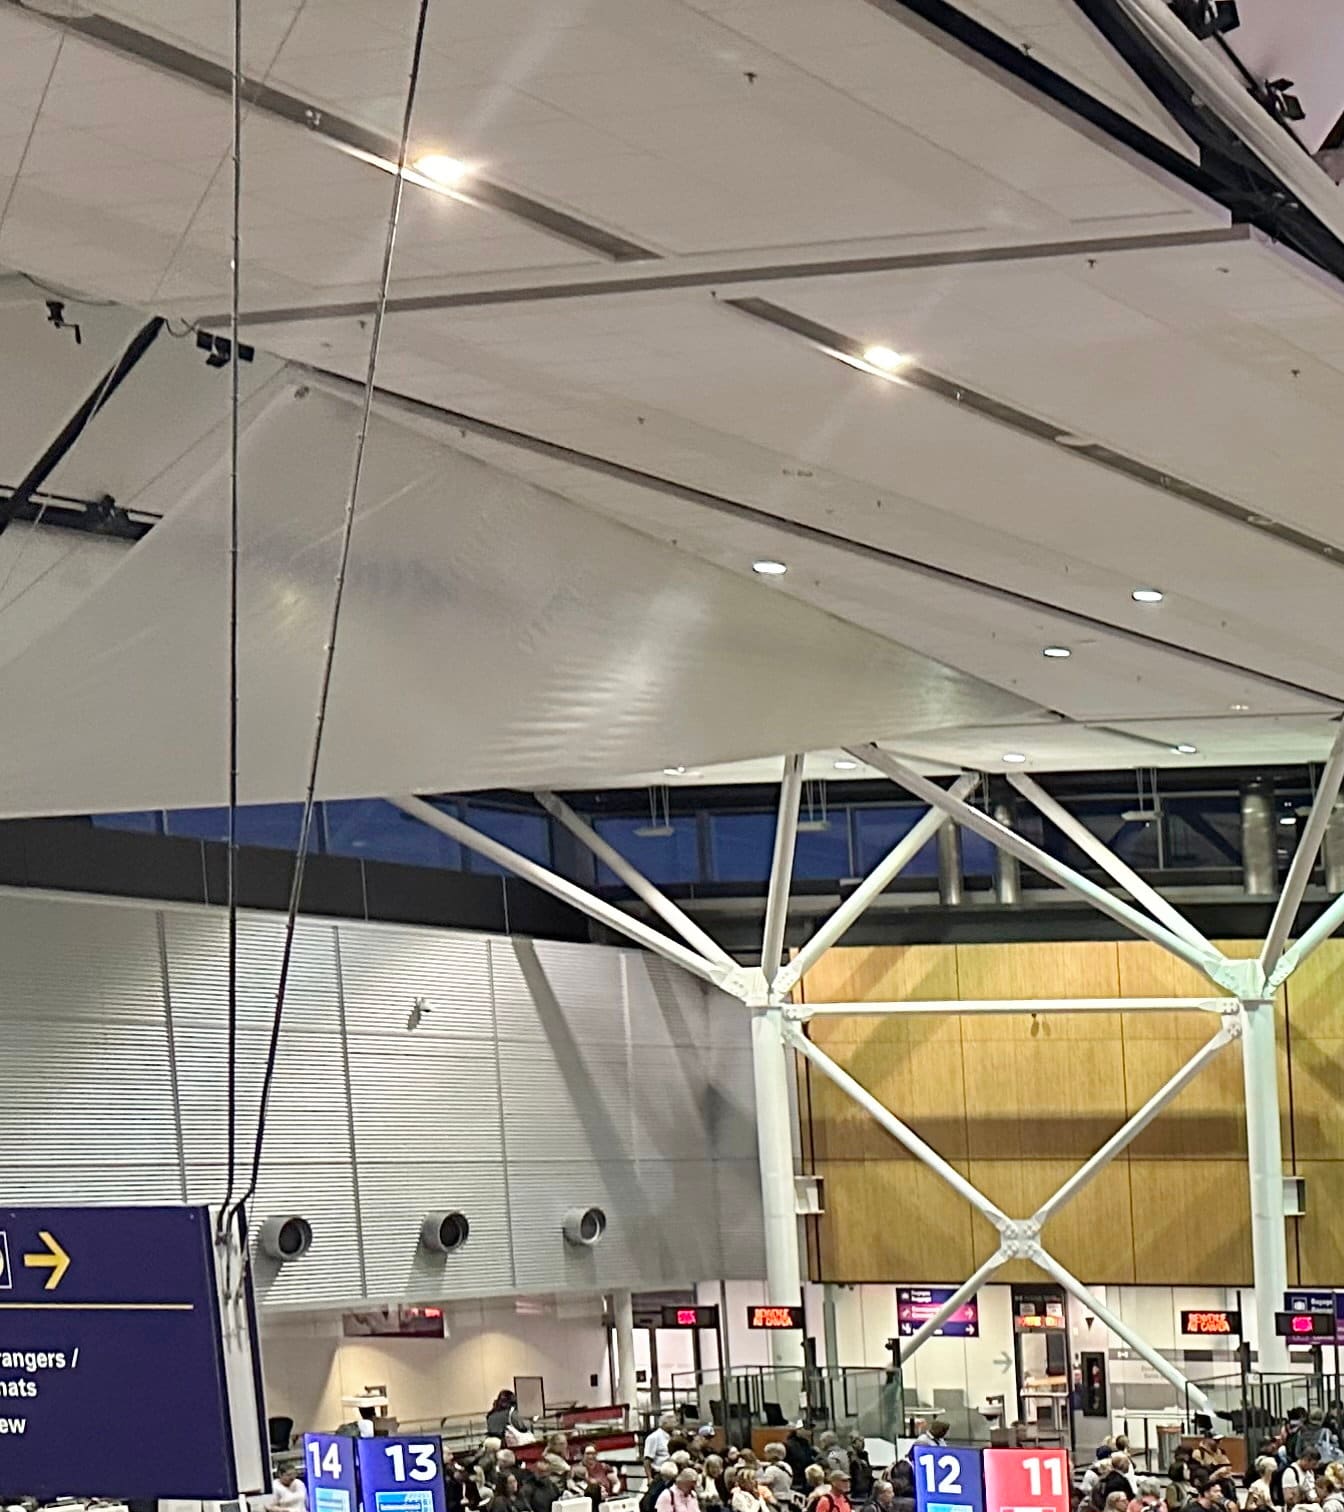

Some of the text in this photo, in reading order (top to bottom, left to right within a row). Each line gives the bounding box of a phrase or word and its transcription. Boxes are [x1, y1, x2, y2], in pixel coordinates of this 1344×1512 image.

[308, 1441, 342, 1479] 14
[385, 1444, 437, 1482] 13
[919, 1454, 962, 1494] 12
[1022, 1457, 1063, 1496] 11
